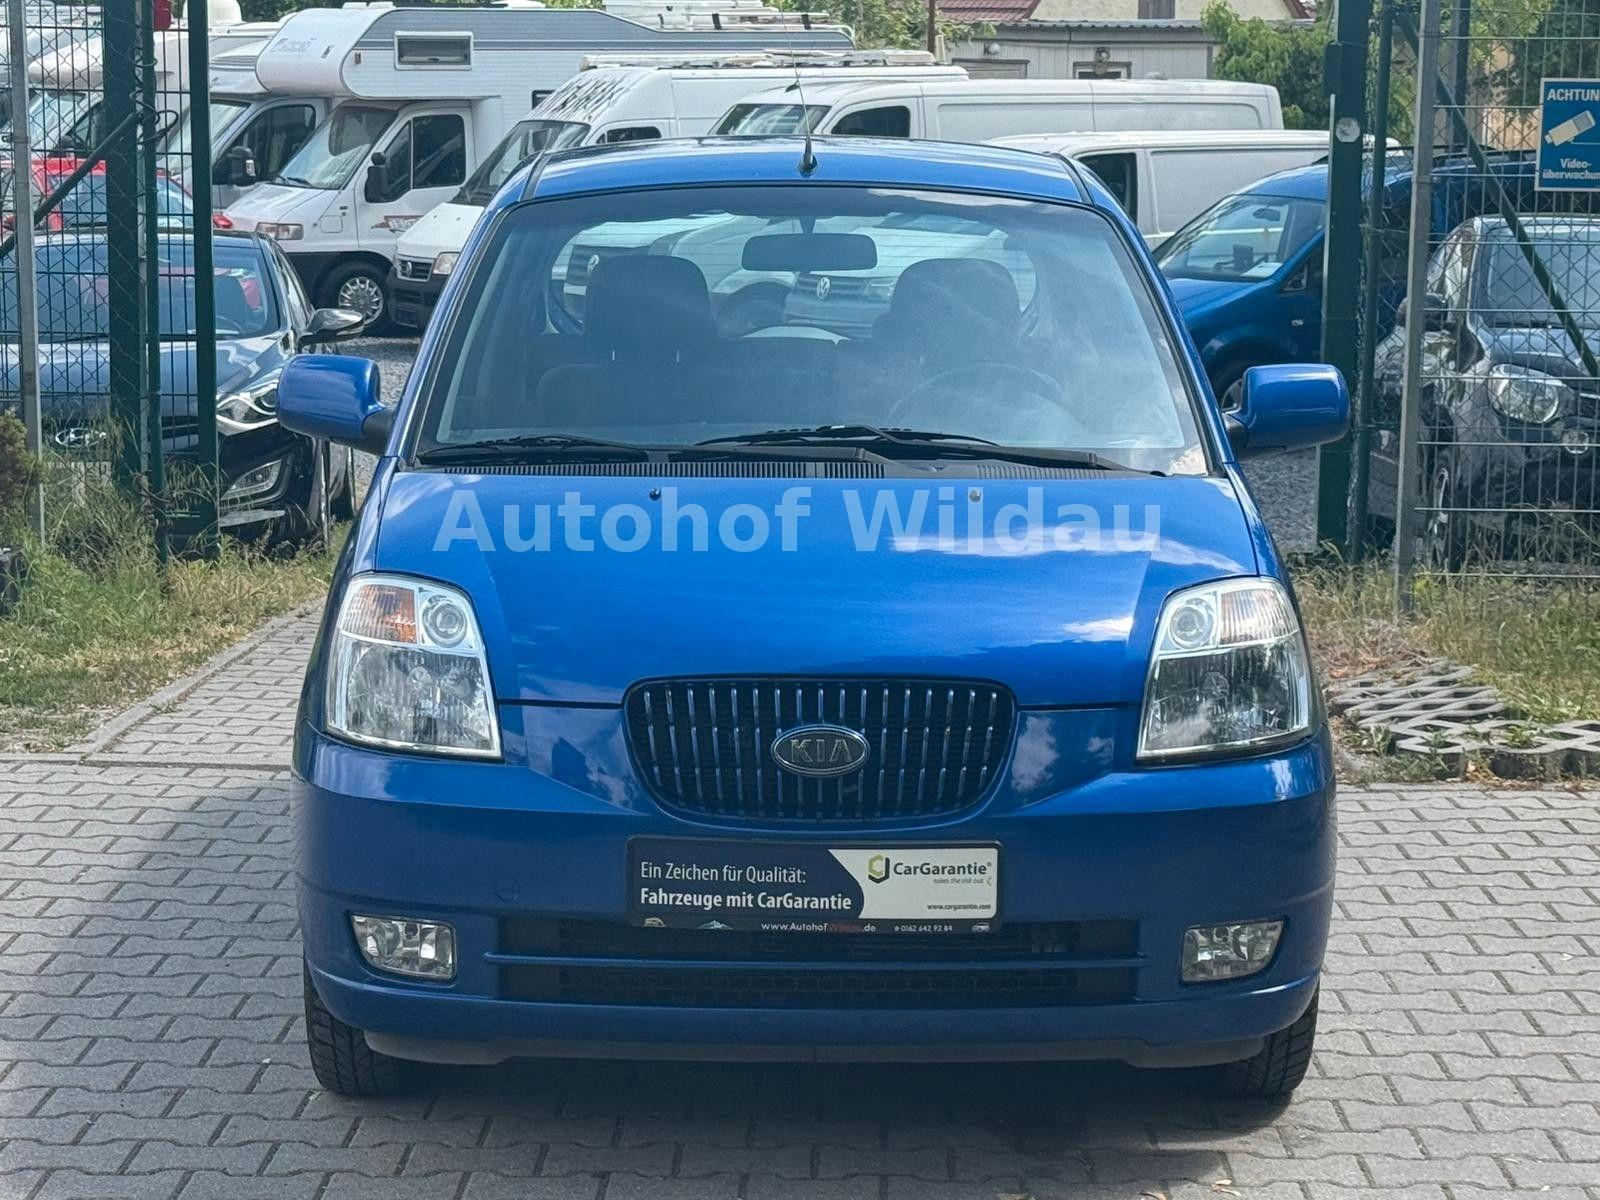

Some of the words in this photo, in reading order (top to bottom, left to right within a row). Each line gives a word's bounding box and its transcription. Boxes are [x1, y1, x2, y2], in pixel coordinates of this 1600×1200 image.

[1560, 158, 1592, 169] Video-
[790, 739, 853, 762] KIA
[641, 861, 662, 879] Ein
[665, 862, 719, 881] Zeichen
[722, 864, 743, 882] für
[746, 865, 807, 884] Qualität:
[641, 887, 722, 911] Fahrzeuge
[726, 891, 754, 908] mit
[758, 892, 852, 910] CarGarantie
